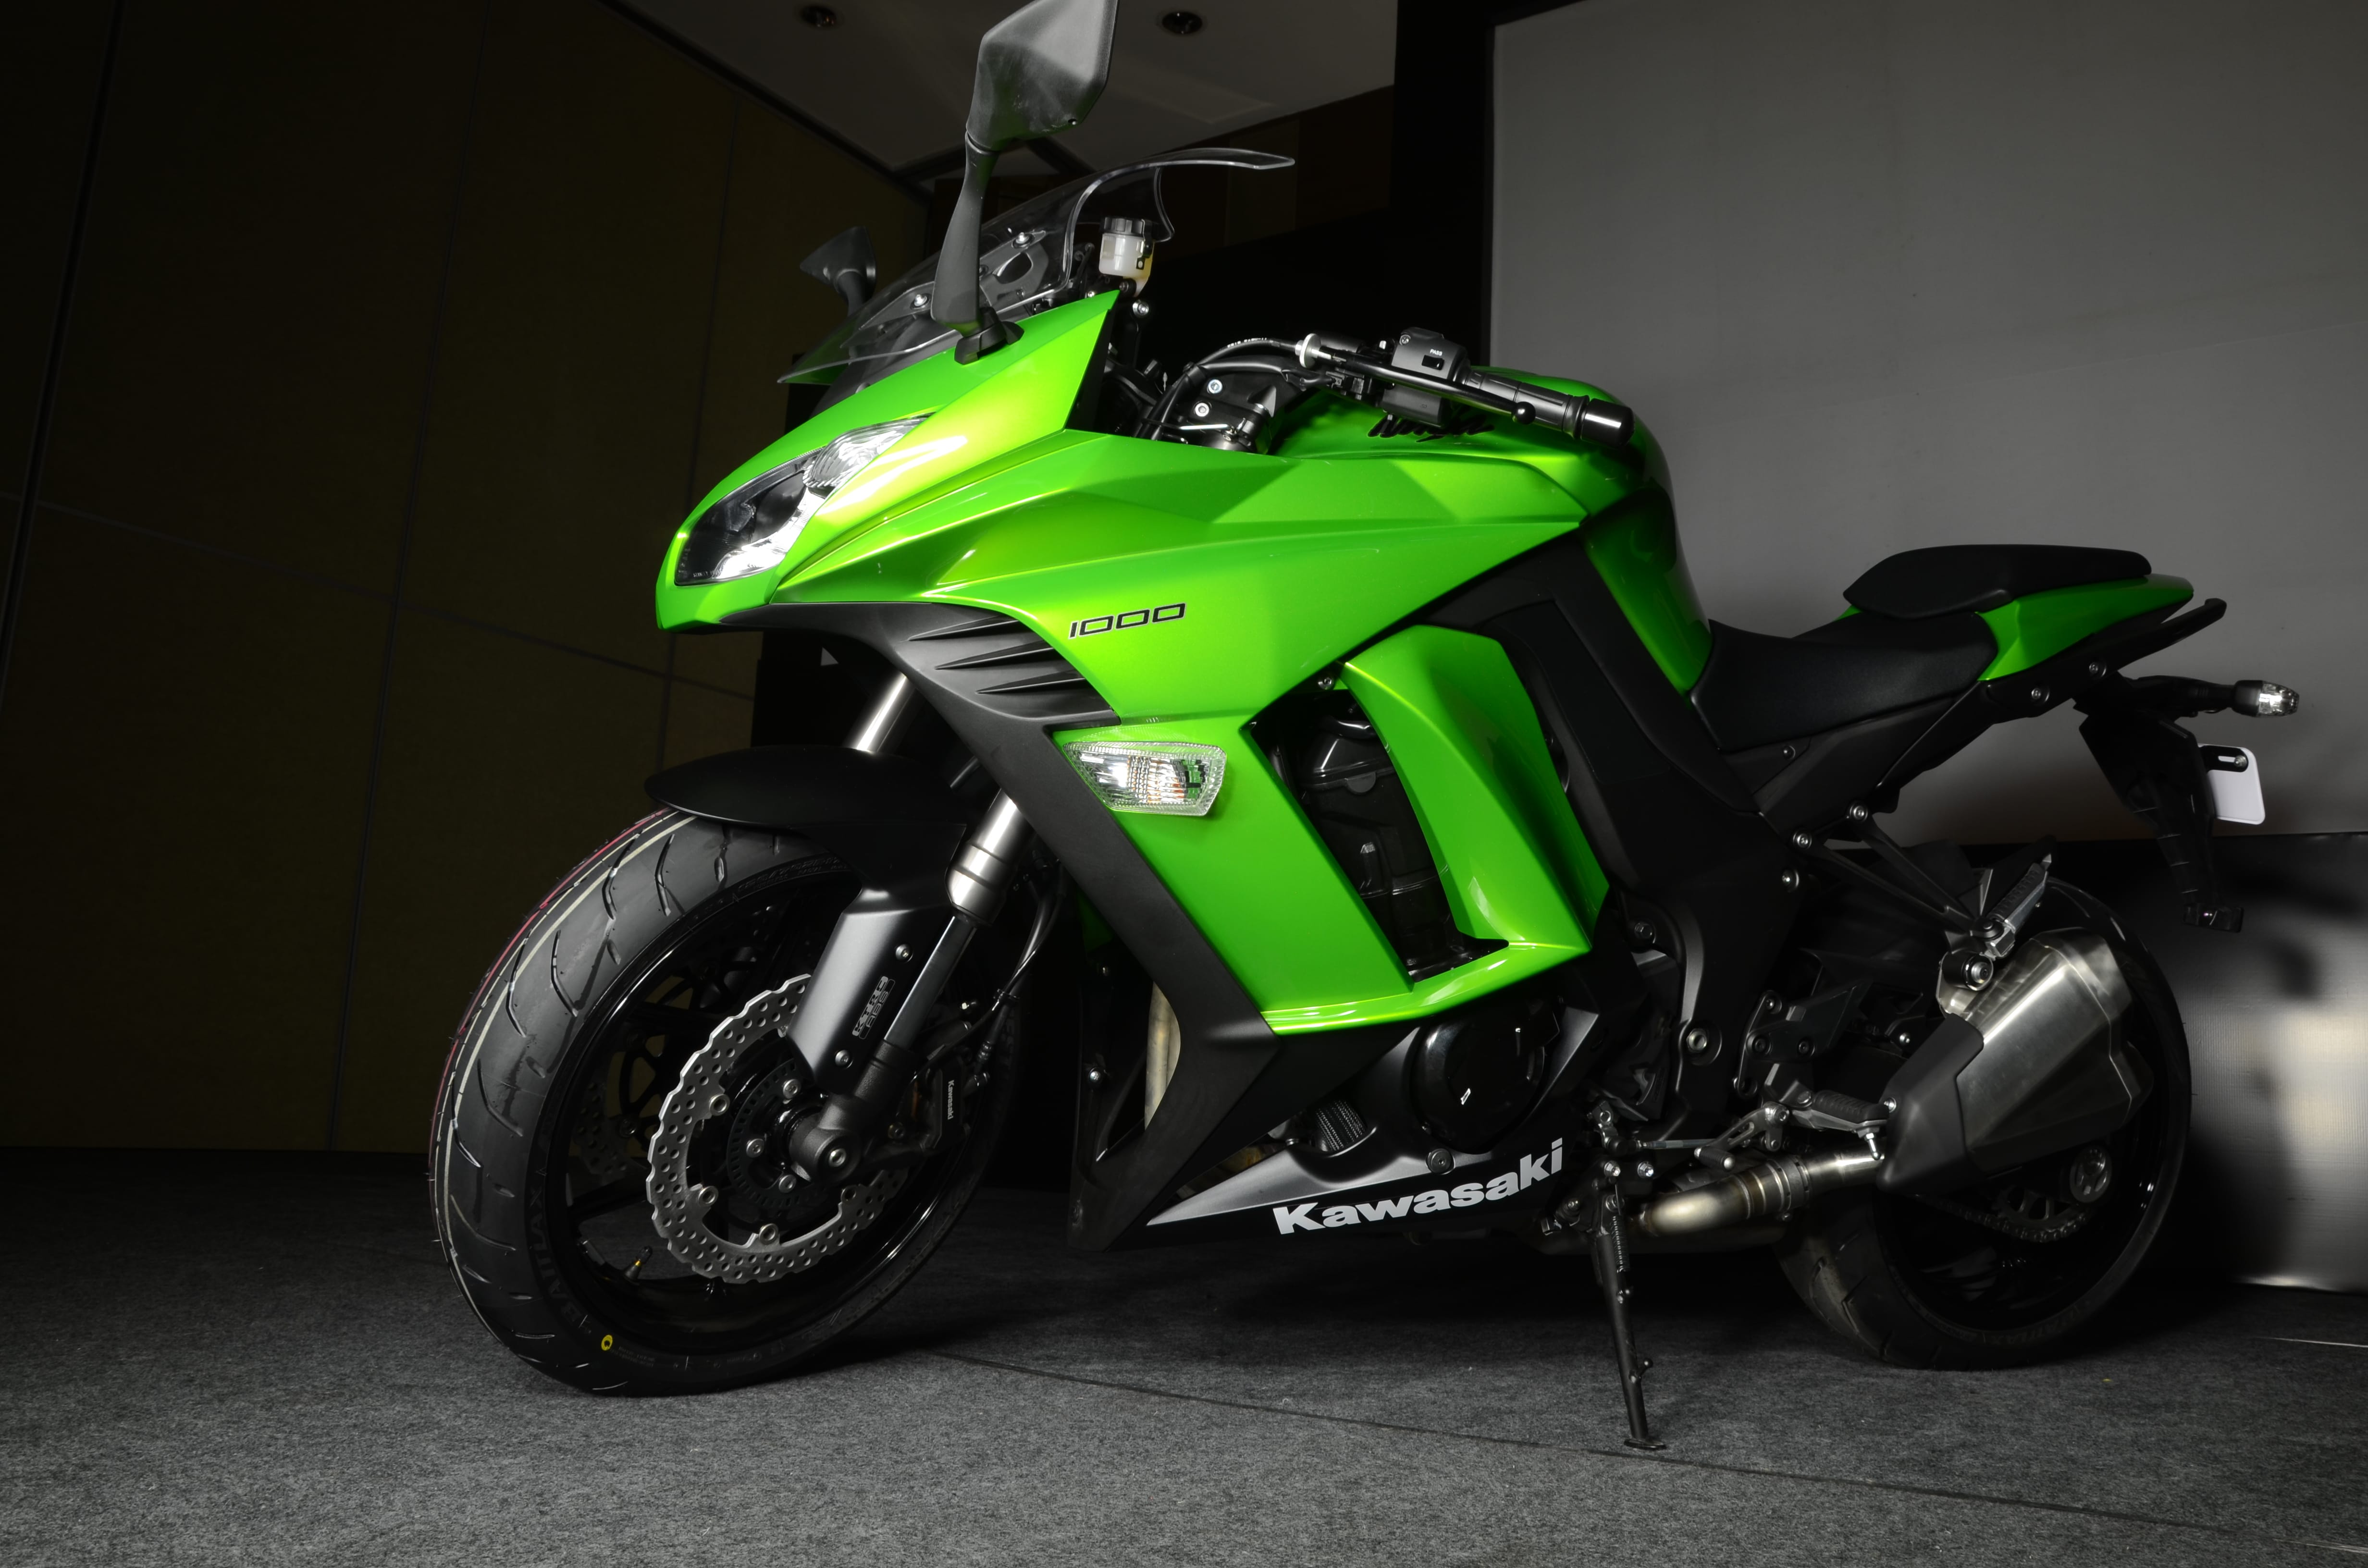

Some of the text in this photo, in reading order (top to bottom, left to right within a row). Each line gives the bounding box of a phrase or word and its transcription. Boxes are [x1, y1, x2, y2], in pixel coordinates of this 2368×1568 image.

[1068, 602, 1186, 639] 1000
[865, 990, 888, 1028] ABS
[1272, 1137, 1563, 1235] Kawasaki
